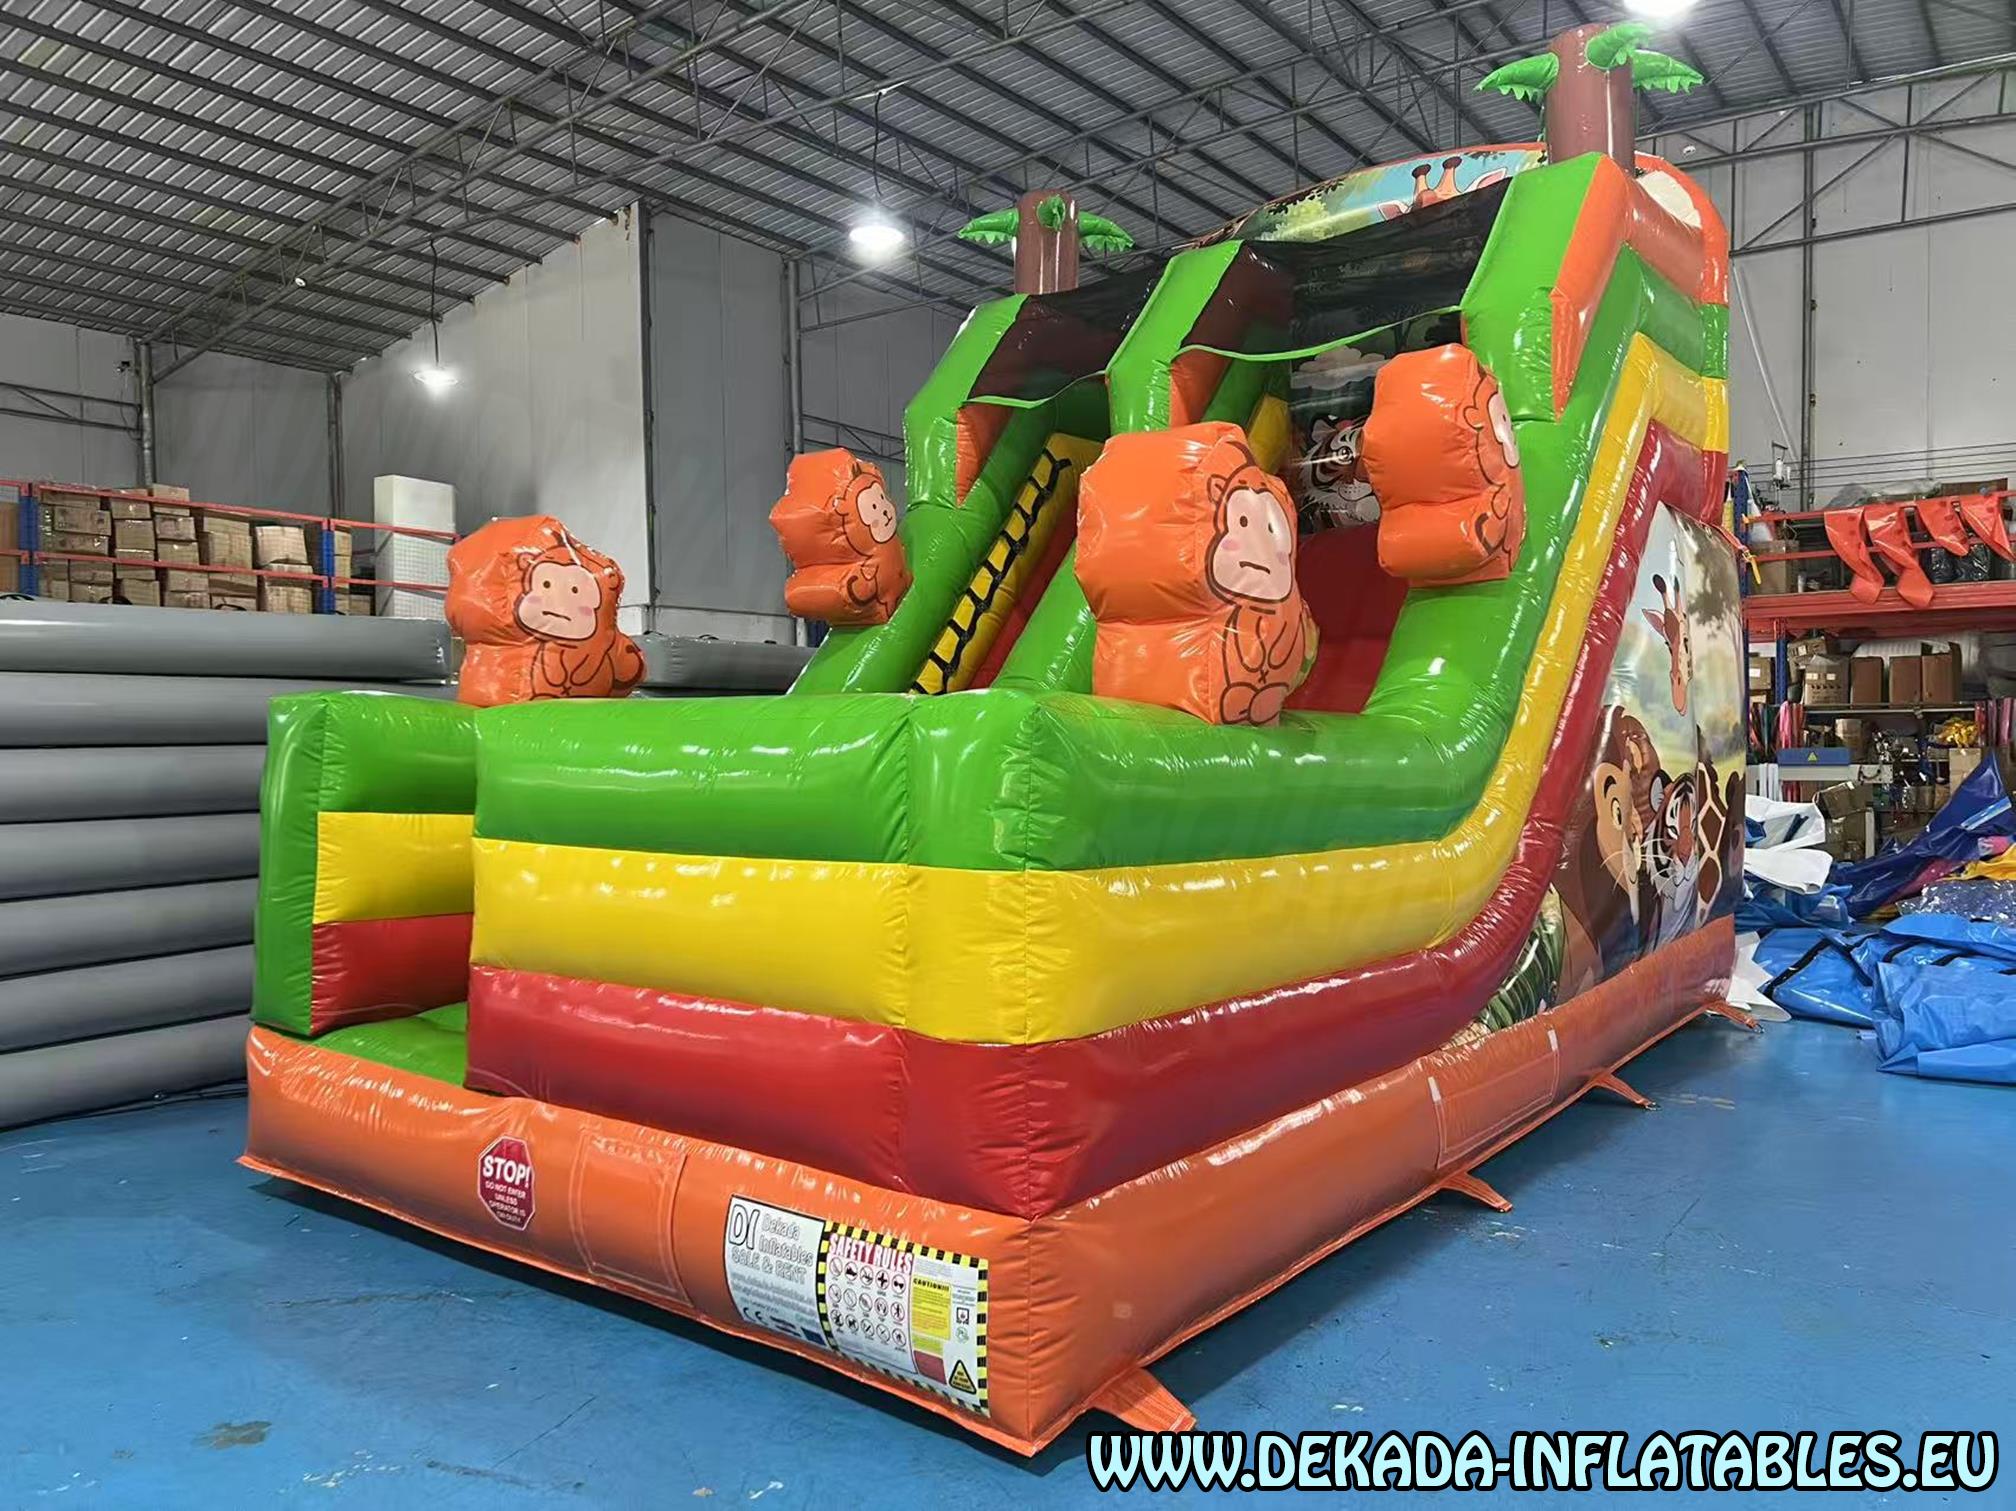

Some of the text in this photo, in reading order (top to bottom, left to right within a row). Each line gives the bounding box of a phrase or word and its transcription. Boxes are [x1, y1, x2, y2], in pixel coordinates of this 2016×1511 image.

[482, 1155, 531, 1188] STOP!
[761, 1213, 799, 1240] Dekada
[759, 1235, 814, 1267] Inflatables
[829, 1232, 877, 1266] SAFETY
[875, 1245, 914, 1275] RULES
